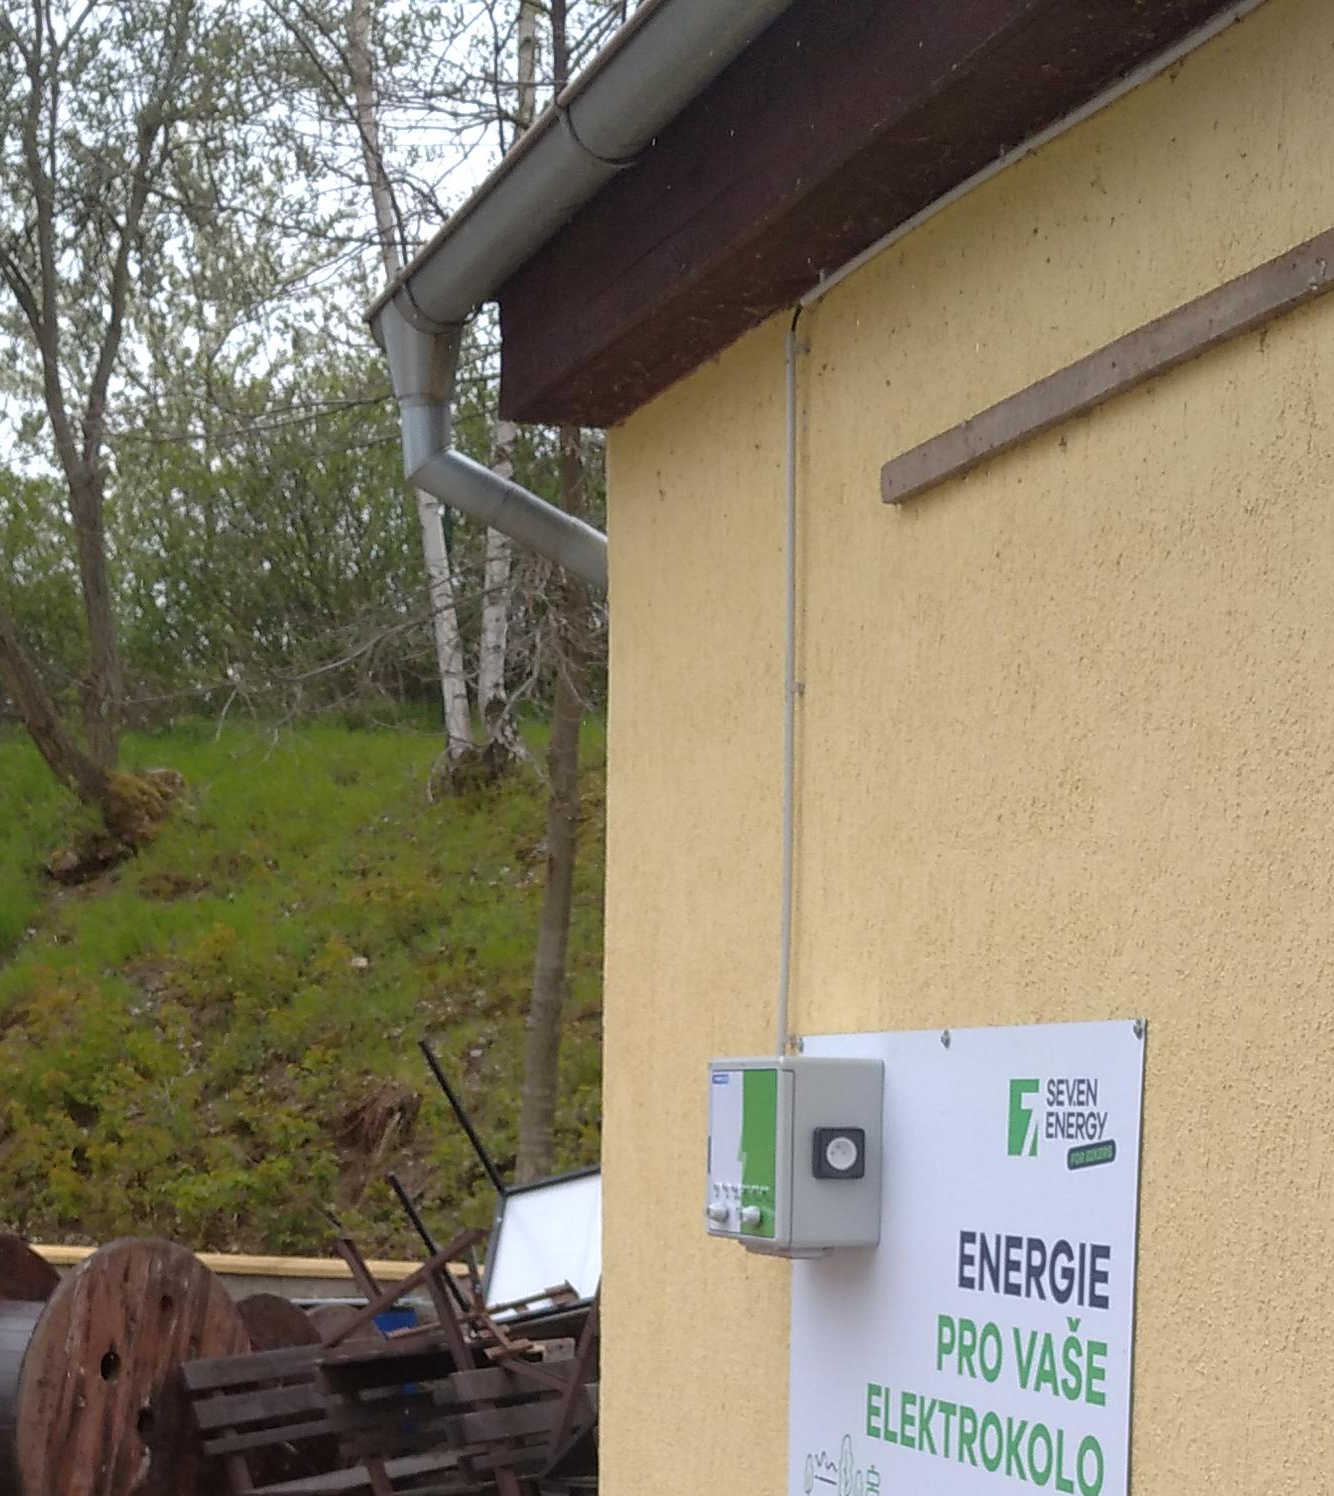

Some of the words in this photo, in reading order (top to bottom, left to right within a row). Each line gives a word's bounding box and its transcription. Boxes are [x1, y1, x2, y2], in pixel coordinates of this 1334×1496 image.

[1045, 1111, 1108, 1140] ENERGY
[958, 1230, 1111, 1310] ENERGIE
[937, 1314, 1003, 1383] PRO
[1012, 1316, 1108, 1407] VAŠE
